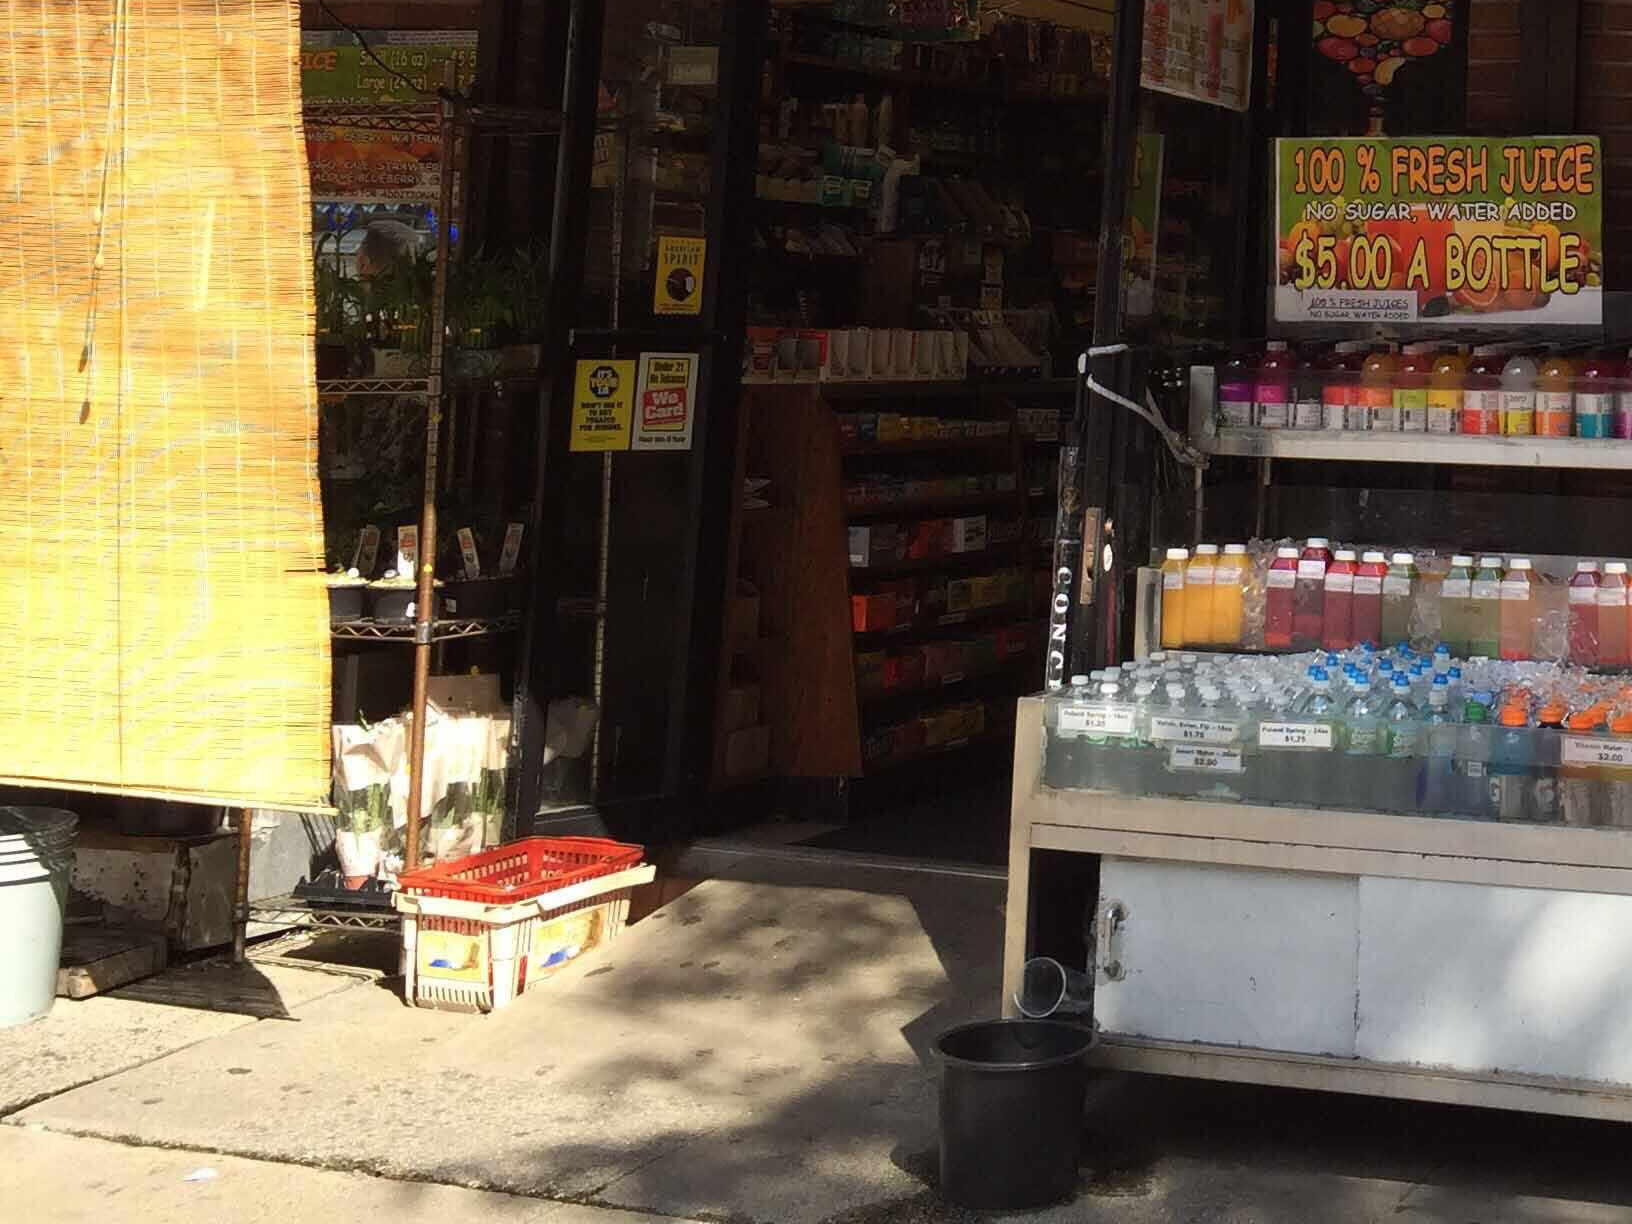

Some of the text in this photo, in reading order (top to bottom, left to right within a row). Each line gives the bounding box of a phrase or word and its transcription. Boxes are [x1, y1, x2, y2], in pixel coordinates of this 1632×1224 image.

[1295, 143, 1595, 195] 100 % FRESH JUICE
[1306, 202, 1577, 223] NO SUGAR, WATER ADDED
[1294, 231, 1582, 294] $5.00 A BOTTLE
[652, 391, 676, 404] We
[645, 403, 684, 419] Card
[1598, 753, 1623, 762] $2.00
